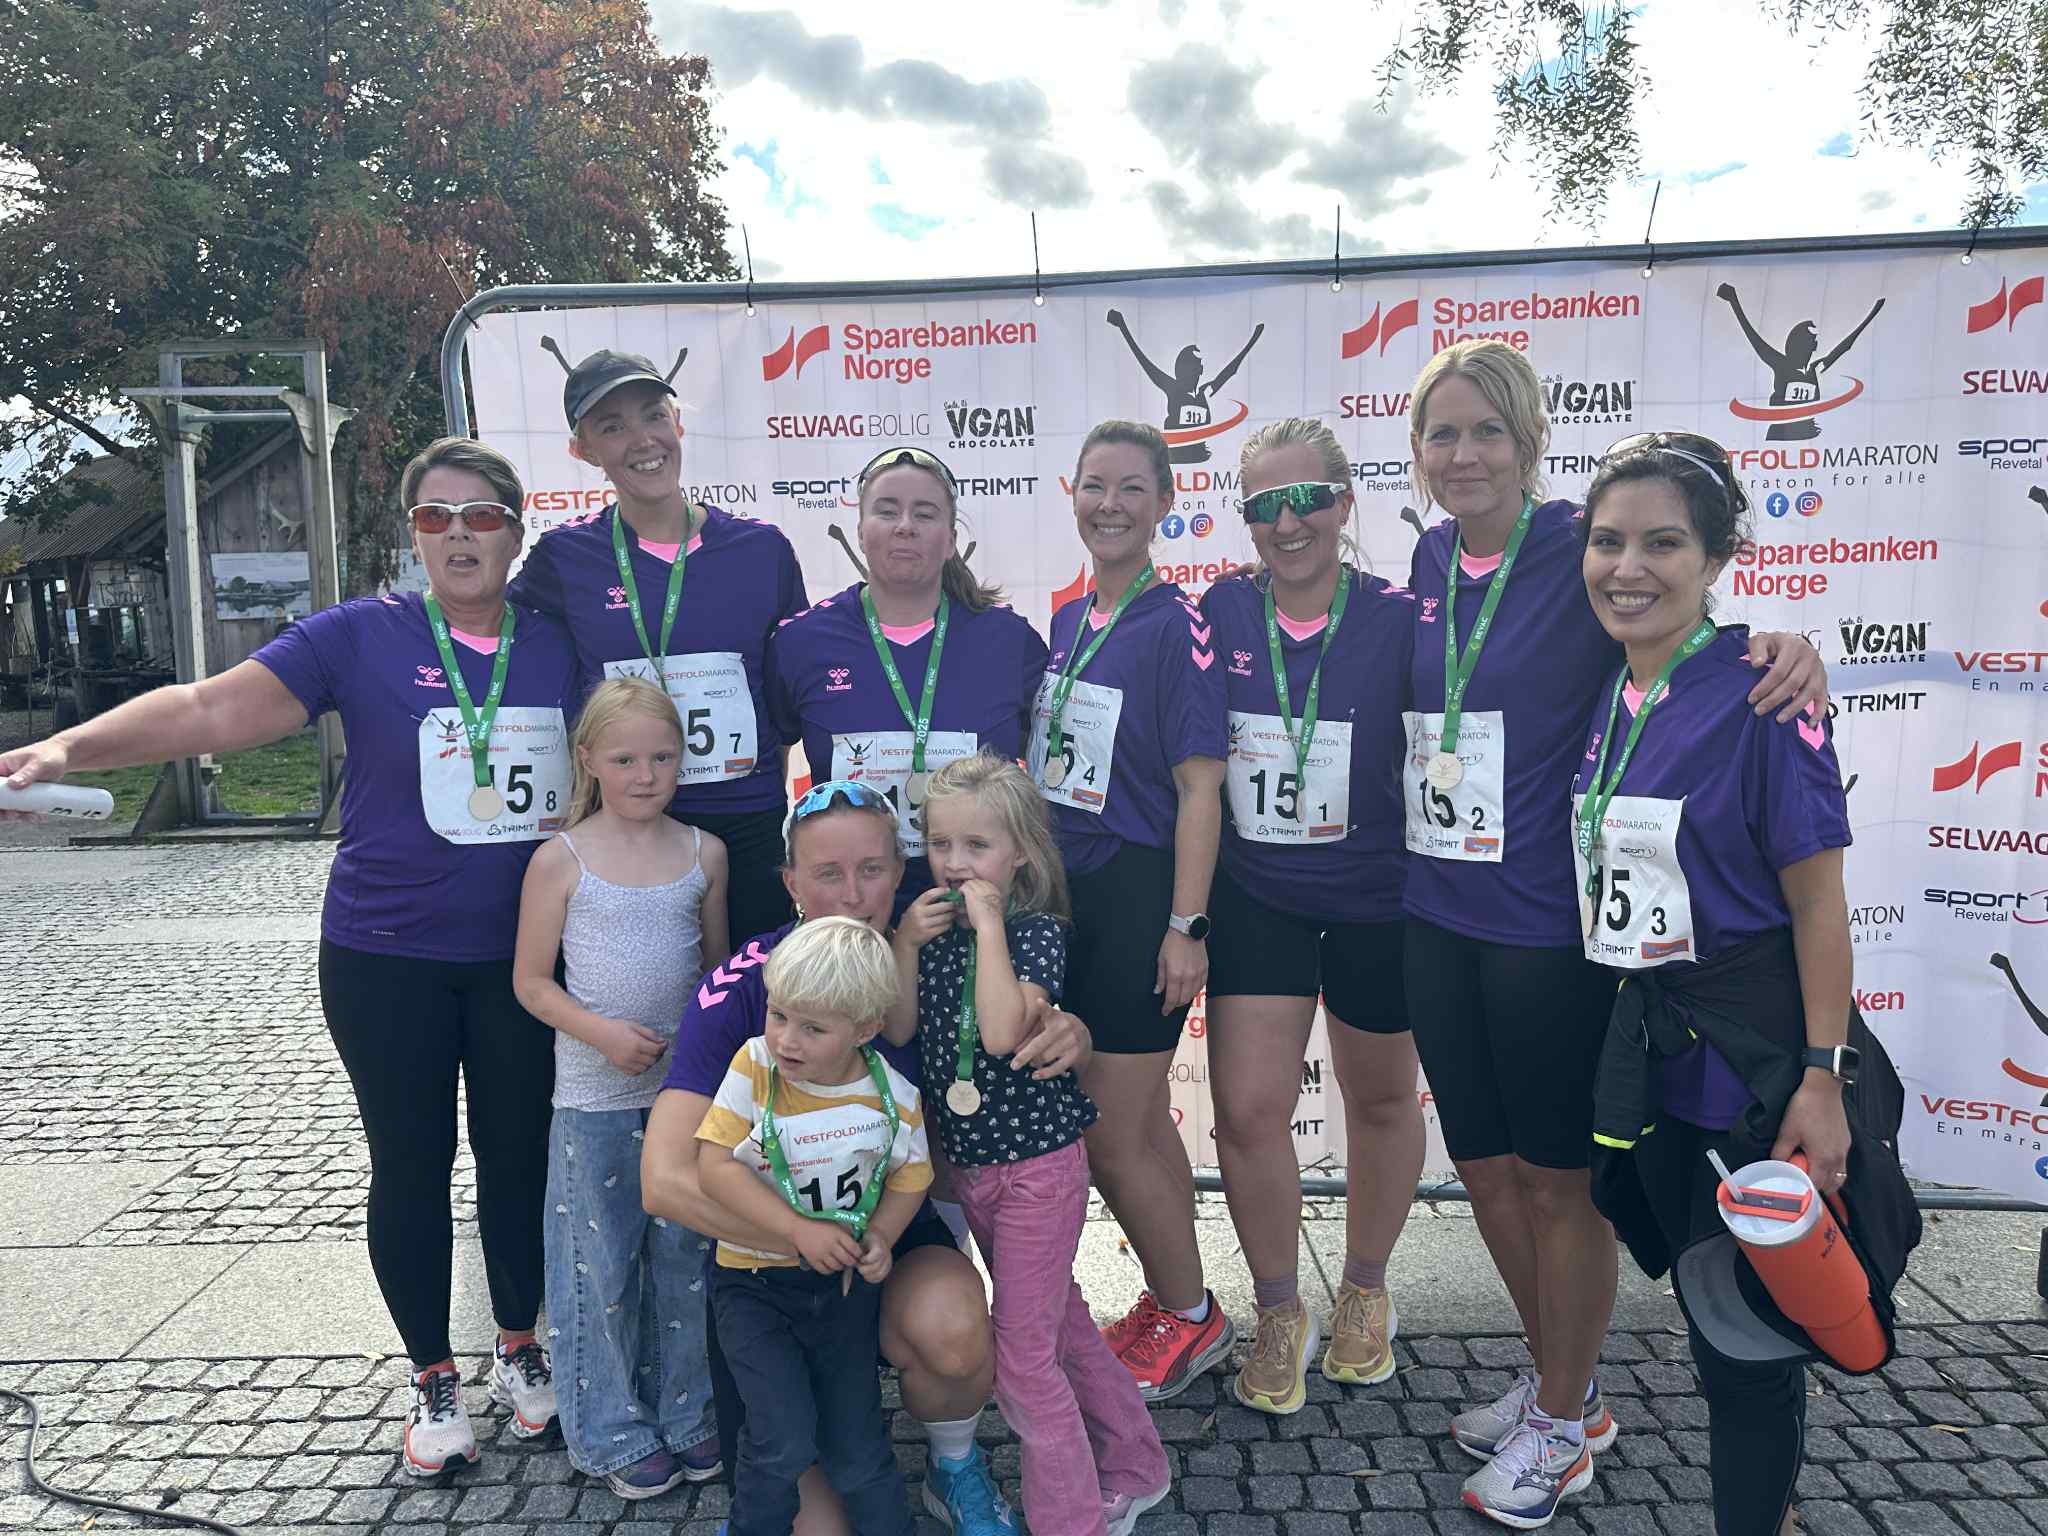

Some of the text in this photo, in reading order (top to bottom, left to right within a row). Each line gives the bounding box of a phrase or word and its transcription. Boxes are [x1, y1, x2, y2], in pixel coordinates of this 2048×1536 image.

[1433, 291, 1639, 329] Sparebanken
[843, 319, 1036, 354] Sparebanken
[844, 354, 931, 384] Norge
[1340, 393, 1411, 419] SELVA
[1542, 381, 1632, 414] VGAN
[946, 407, 1034, 438] VGAN
[1551, 414, 1632, 424] HOCOLATE
[948, 438, 1035, 448] CHOCOLATE
[1958, 439, 2048, 459] spor
[1544, 455, 1606, 474] TRIM
[1728, 444, 1938, 470] TFOLDMARATON
[1991, 457, 2042, 469] Revetal
[1349, 461, 1411, 482] spor
[1737, 471, 1926, 489] araton for alle
[772, 478, 850, 498] sport
[955, 477, 1038, 497] TRIMIT
[1367, 480, 1410, 491] Reveta
[798, 497, 837, 509] Revetal
[1736, 536, 1937, 570] Sparebanken
[1498, 556, 1512, 579] REVAC
[1733, 570, 1828, 600] Norge
[1475, 616, 1489, 640] REVAC
[1840, 622, 1926, 655] VGAN
[1840, 654, 1926, 665] CHOCOLATE
[826, 683, 852, 692] hummel
[1453, 677, 1466, 701] REVAC
[1646, 679, 1665, 704] REVAC
[1972, 678, 1999, 691] En
[1842, 692, 1926, 713] TRIMIT
[916, 717, 929, 744] 2025
[729, 732, 742, 754] 7
[686, 765, 720, 775] TRIMIT
[1083, 765, 1095, 785] 4
[545, 790, 557, 812] 8
[1249, 769, 1327, 822] 15 1
[1419, 777, 1485, 831] 15 2
[1270, 827, 1304, 837] TRIMIT
[1602, 819, 1662, 831] FOLDMARATON
[1434, 840, 1459, 849] TRIMIT
[1593, 865, 1667, 935] 15 3
[1924, 888, 2028, 908] sport
[1954, 908, 2008, 923] Revetal
[1853, 930, 1892, 944] alle
[1600, 943, 1635, 956] TRIMIT
[793, 1118, 892, 1146] VESTFOLDMARATO
[1937, 1121, 1962, 1136] En
[798, 1164, 863, 1212] 15
